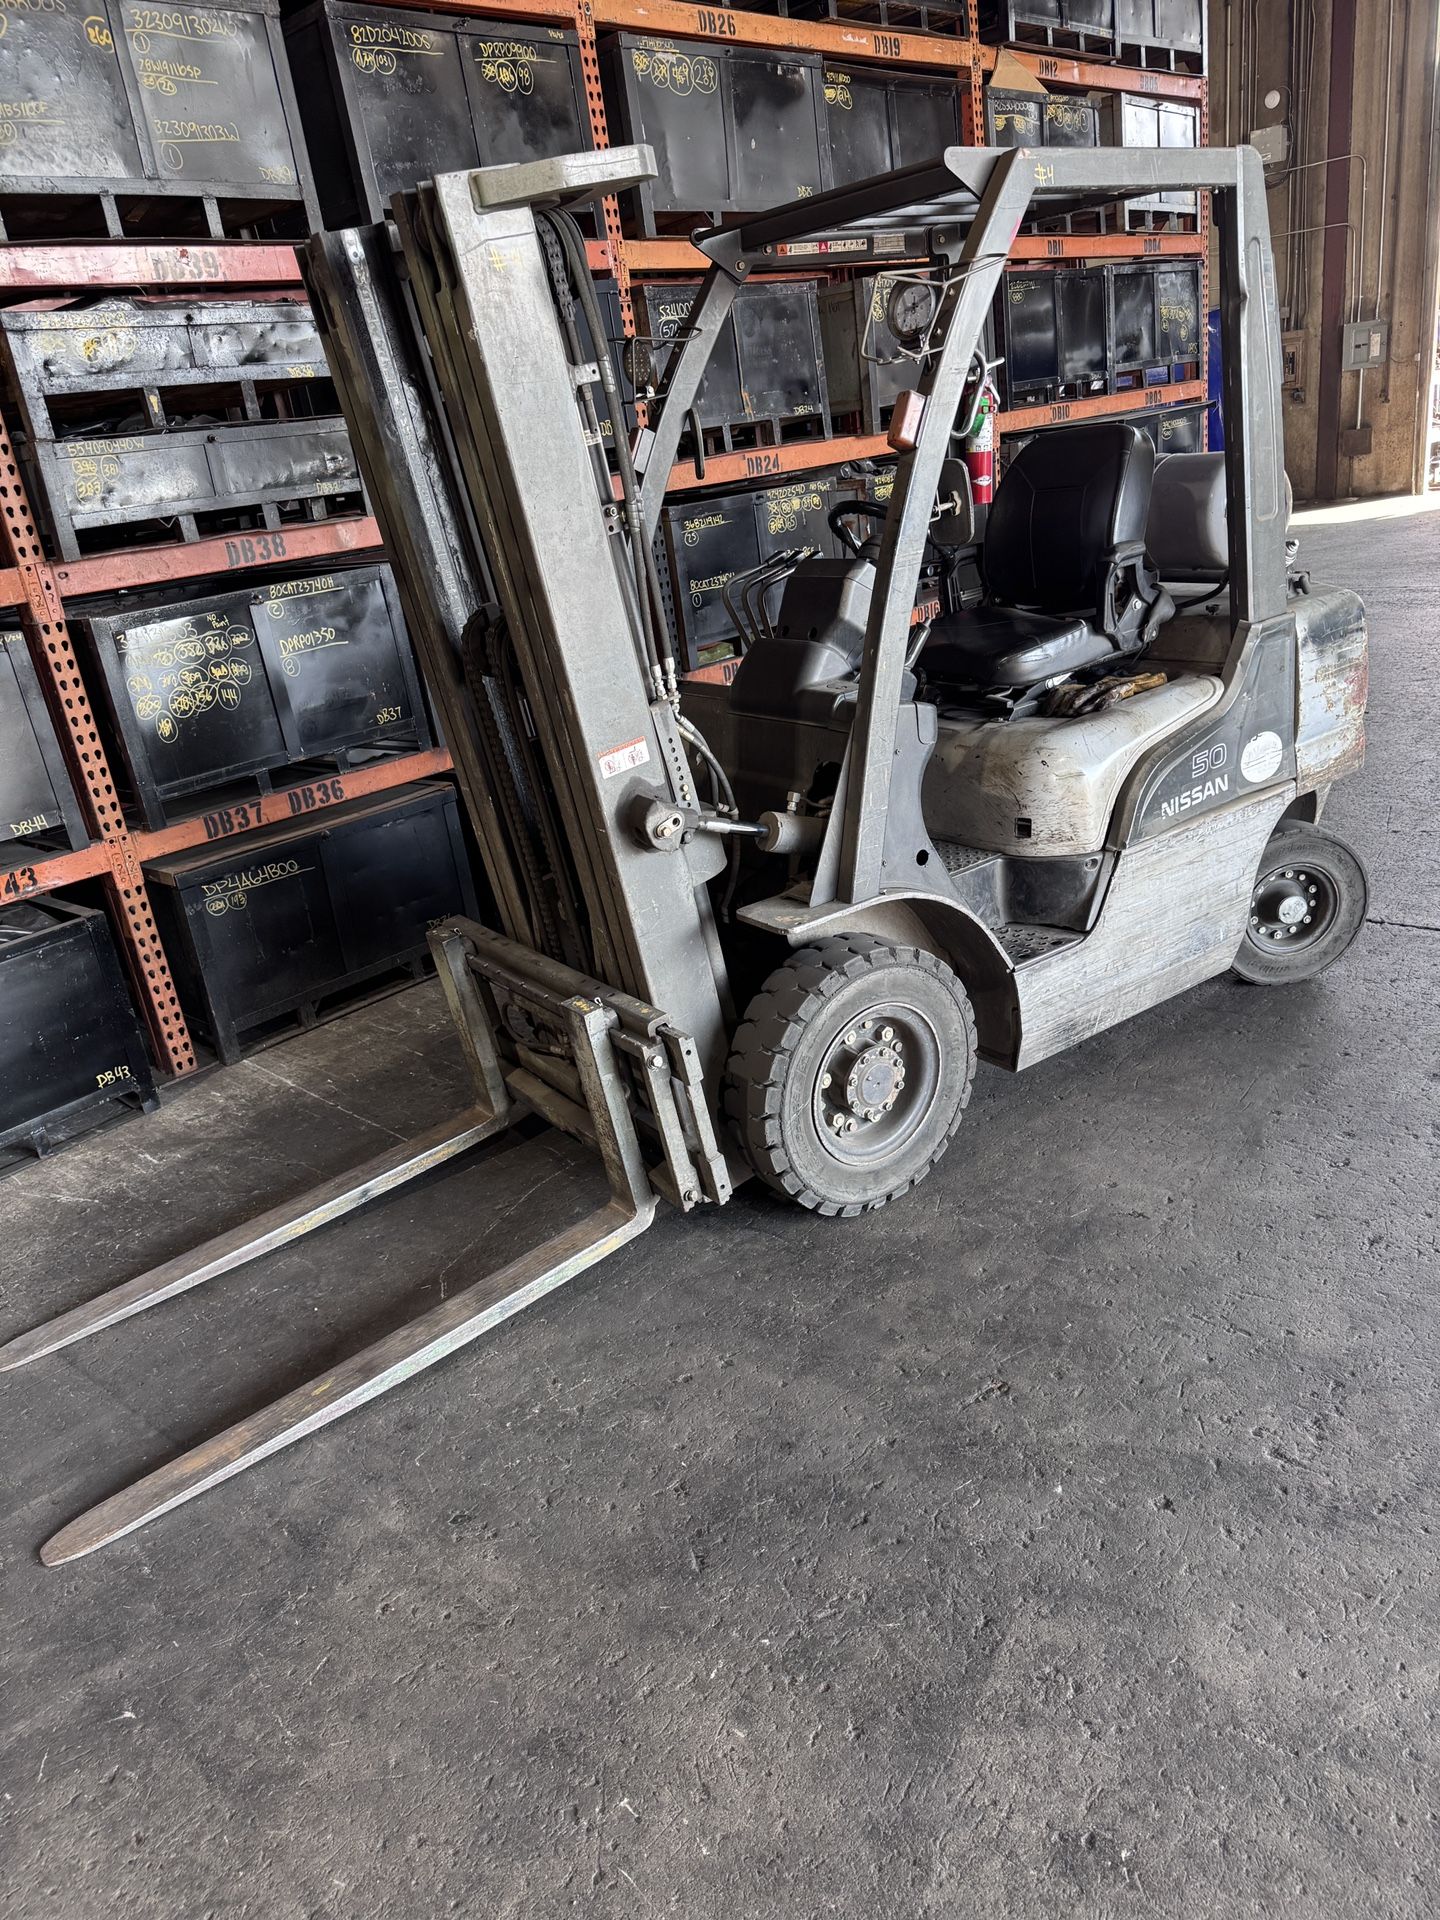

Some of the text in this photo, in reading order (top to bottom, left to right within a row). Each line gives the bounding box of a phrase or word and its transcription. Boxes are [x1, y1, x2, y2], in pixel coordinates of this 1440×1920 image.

[699, 10, 736, 36] DB26
[873, 35, 900, 57] DB19
[1039, 59, 1058, 78] DB12
[1034, 163, 1054, 186] #4
[1047, 240, 1064, 256] DB11
[1051, 404, 1070, 422] DB10
[746, 453, 780, 478] DB24
[224, 533, 286, 568] DB38
[377, 706, 401, 725] DB37
[1192, 743, 1227, 779] 50
[287, 779, 344, 815] DB36
[1161, 773, 1229, 820] NISSAN
[10, 813, 49, 837] DB44
[202, 801, 263, 840] DB37
[0, 867, 38, 897] 43
[96, 1065, 131, 1089] DB43
